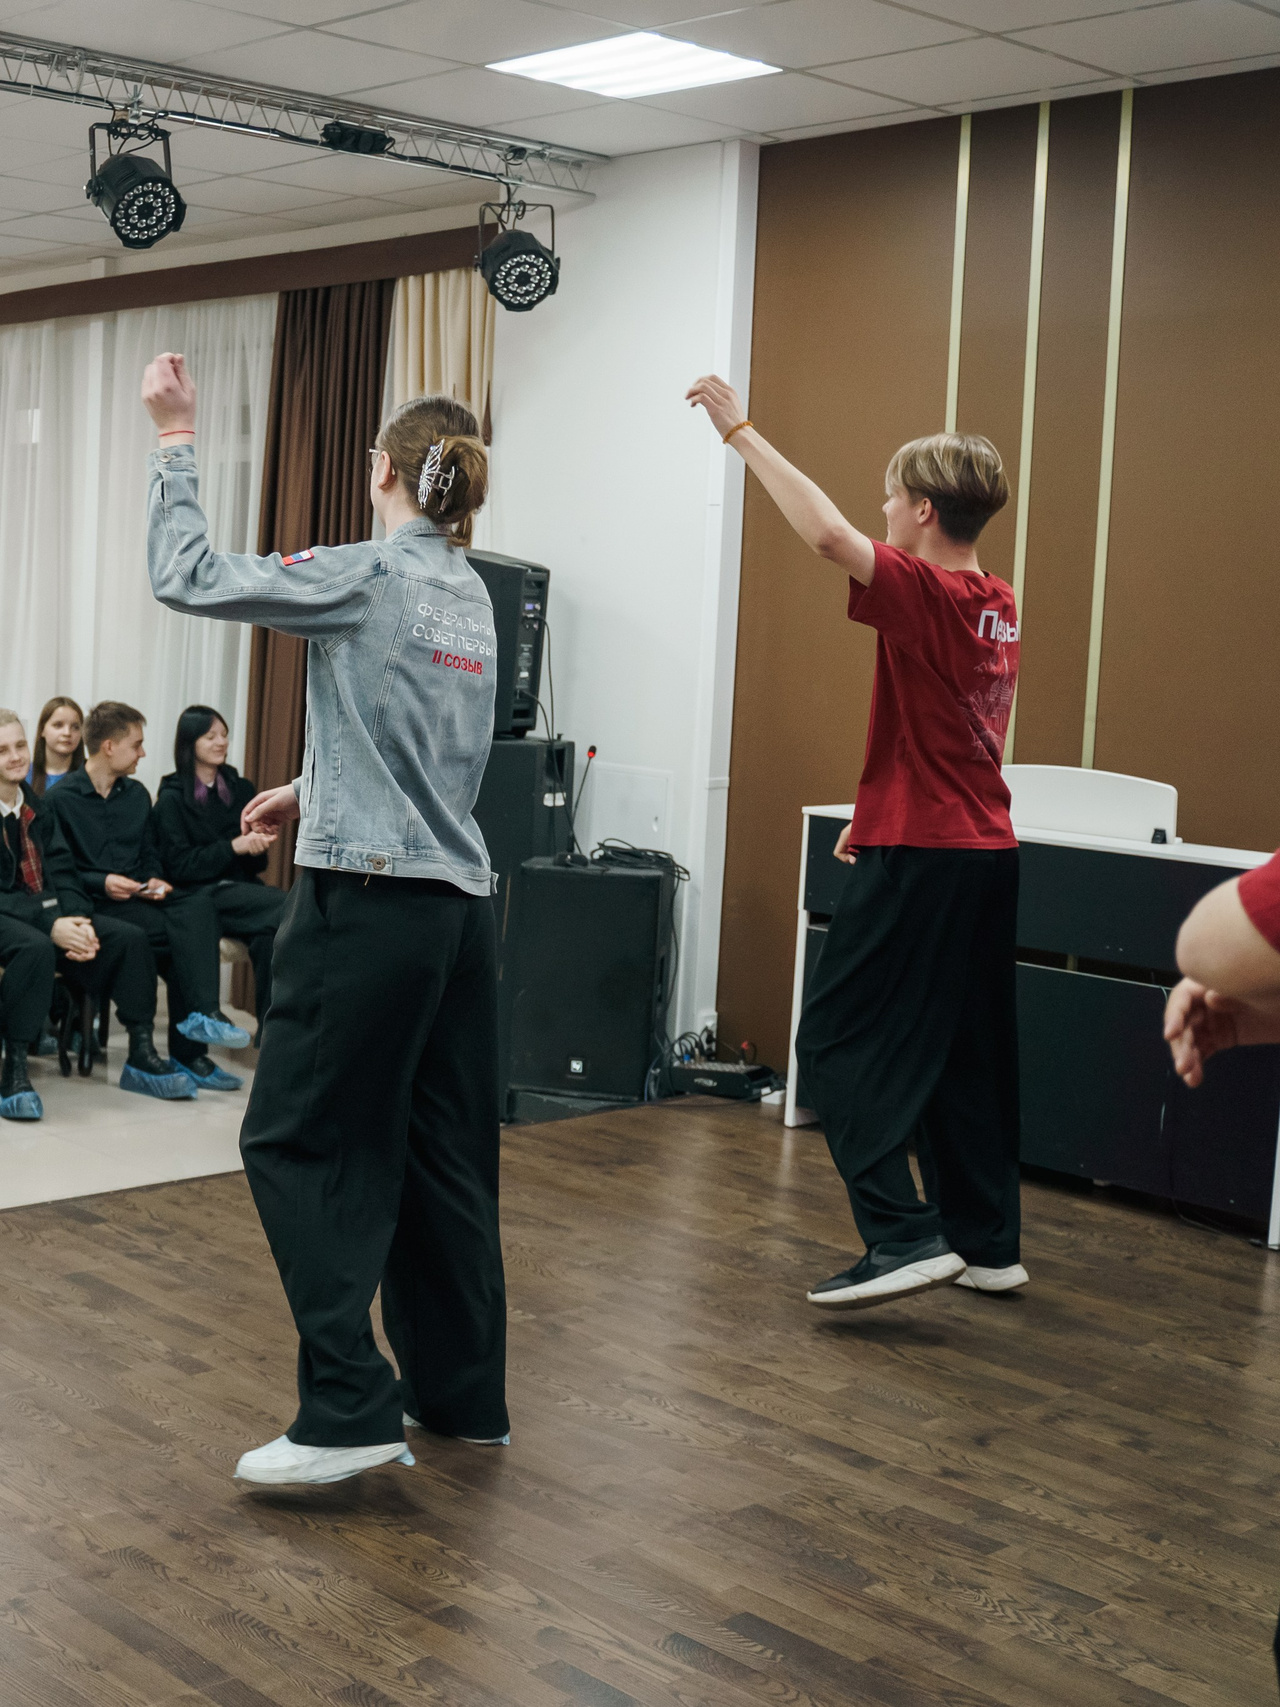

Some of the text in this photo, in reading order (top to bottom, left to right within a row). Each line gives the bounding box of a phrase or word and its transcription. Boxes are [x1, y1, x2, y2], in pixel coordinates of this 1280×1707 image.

[412, 623, 457, 647] СОВЕТ
[432, 649, 483, 676] II СОЗЫВ
